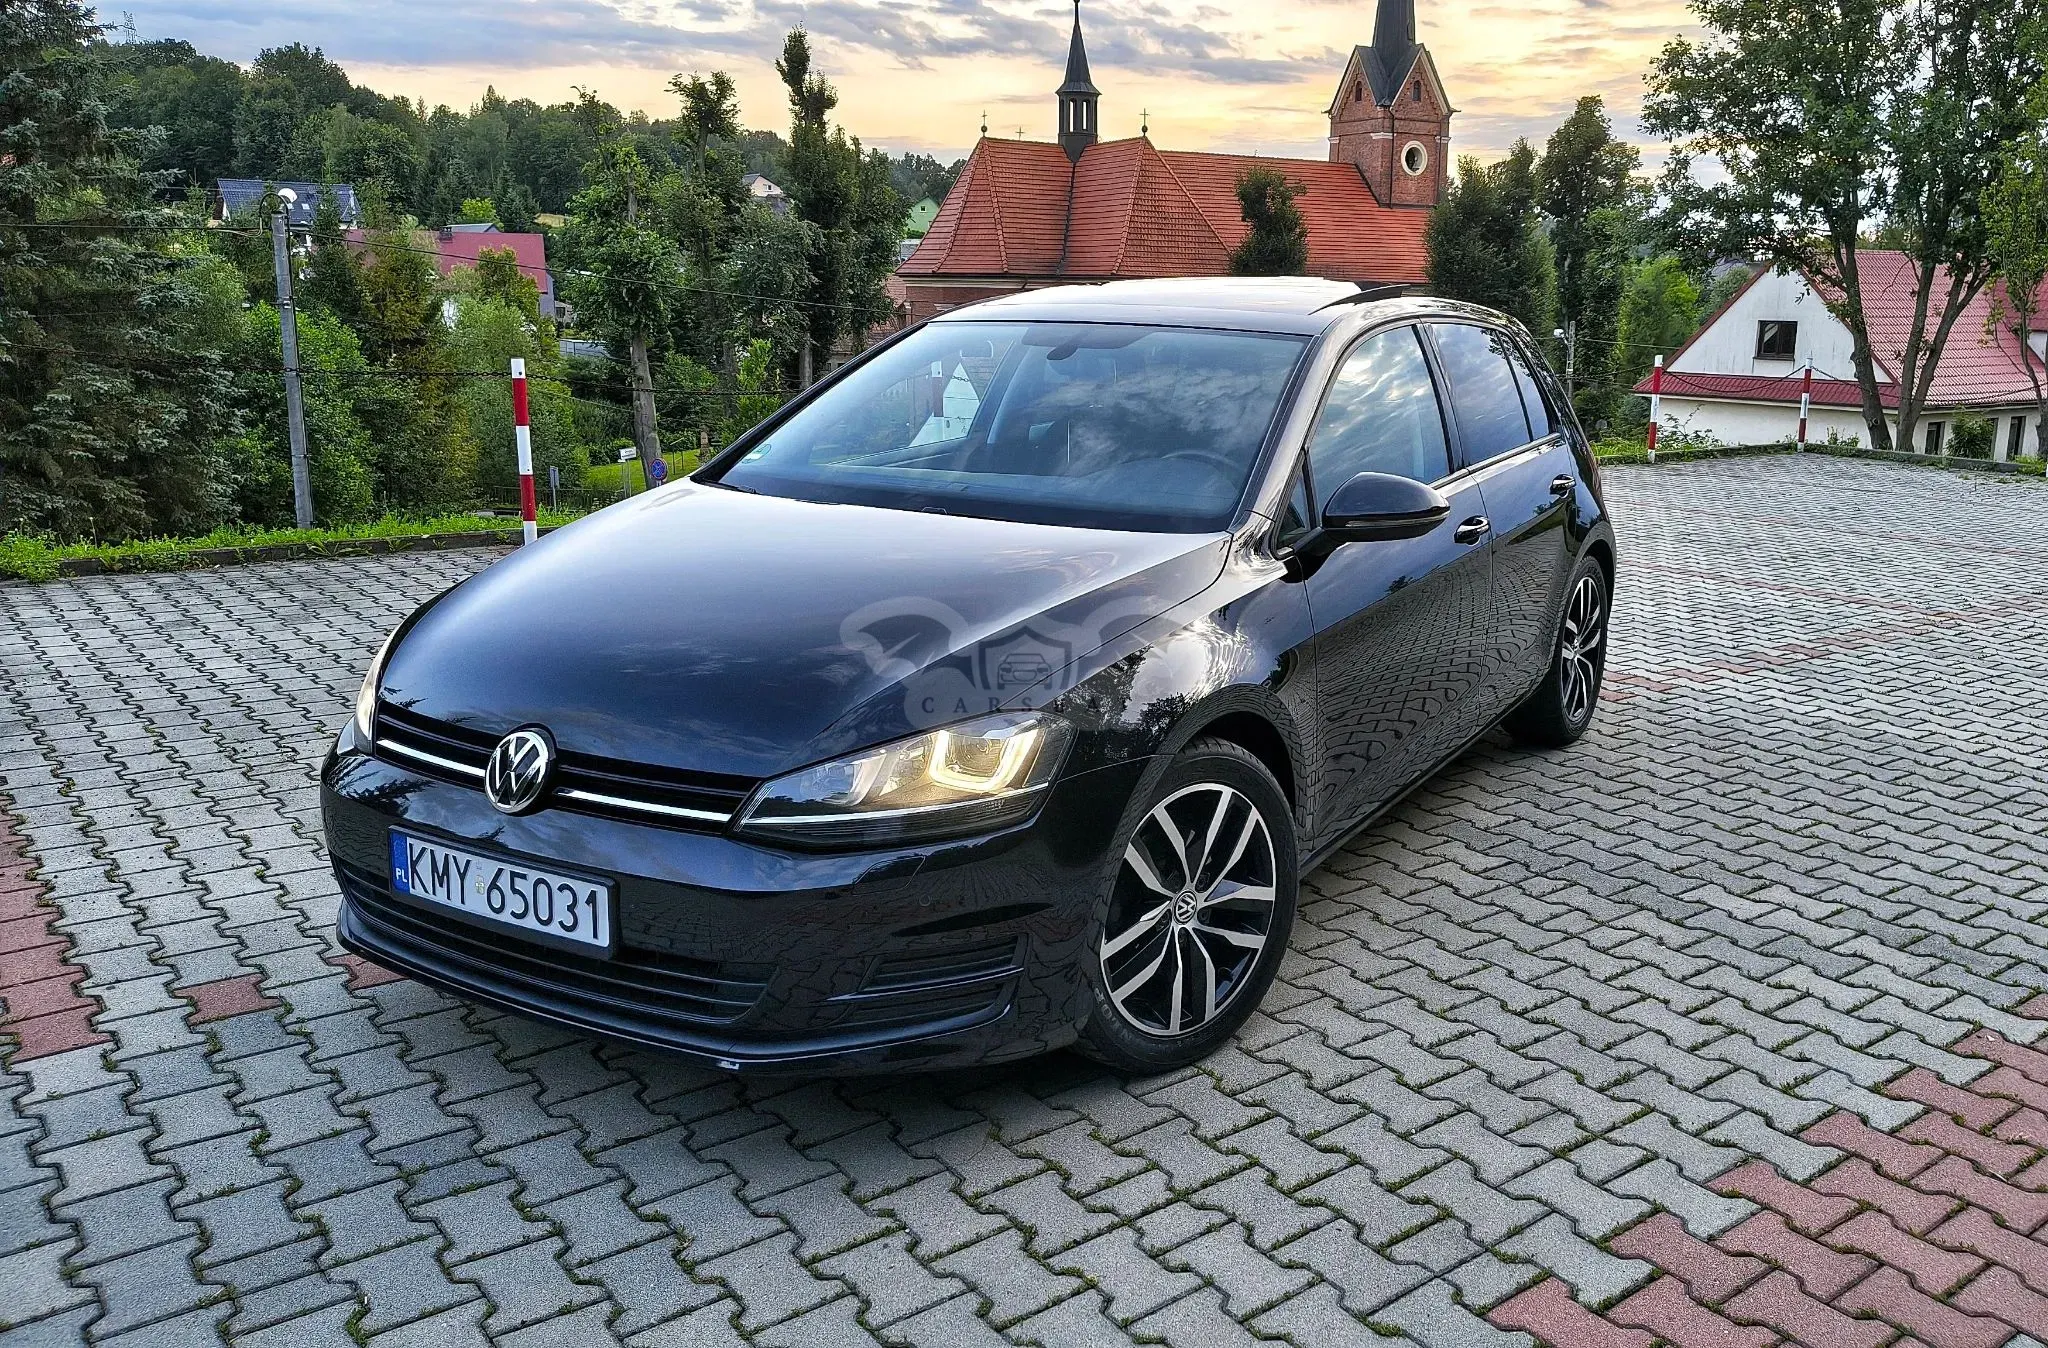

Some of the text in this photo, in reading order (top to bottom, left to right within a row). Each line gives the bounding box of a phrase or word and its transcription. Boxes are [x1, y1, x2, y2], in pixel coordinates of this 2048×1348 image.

[395, 867, 408, 883] PL
[409, 843, 598, 940] KMY 65031
